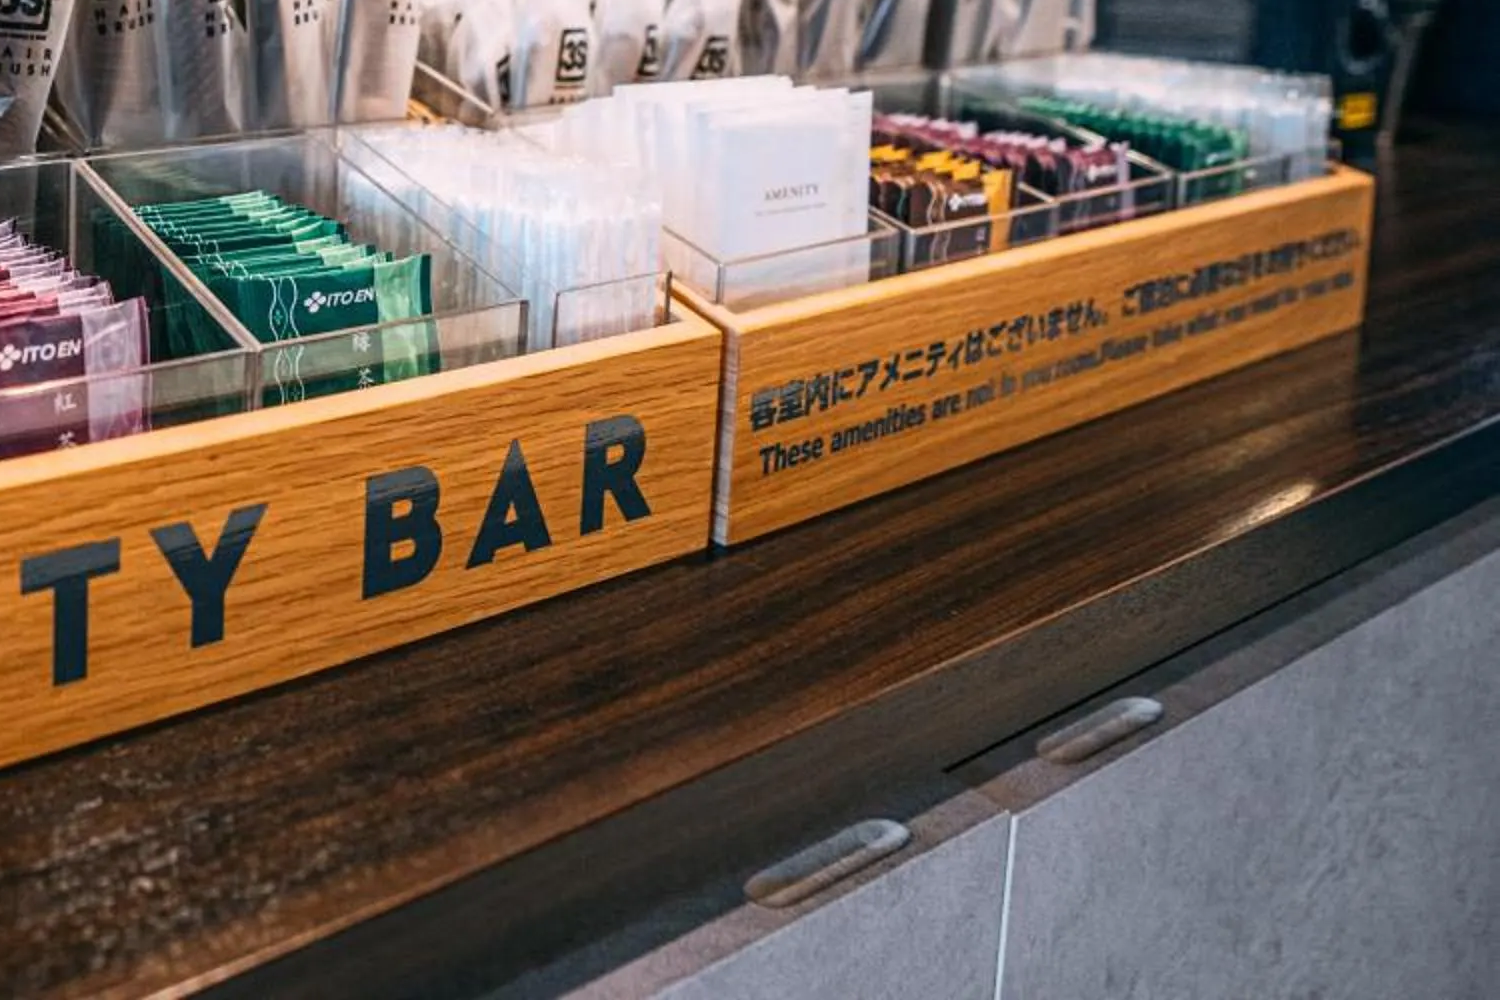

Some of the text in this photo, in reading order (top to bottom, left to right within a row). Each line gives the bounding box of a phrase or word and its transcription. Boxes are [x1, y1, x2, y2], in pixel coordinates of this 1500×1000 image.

[764, 183, 819, 201] AMENITY
[326, 290, 356, 308] ITO
[21, 339, 81, 366] ITO EN
[759, 436, 824, 475] These
[830, 403, 927, 453] amenities
[932, 394, 961, 421] are
[363, 417, 653, 602] BAR
